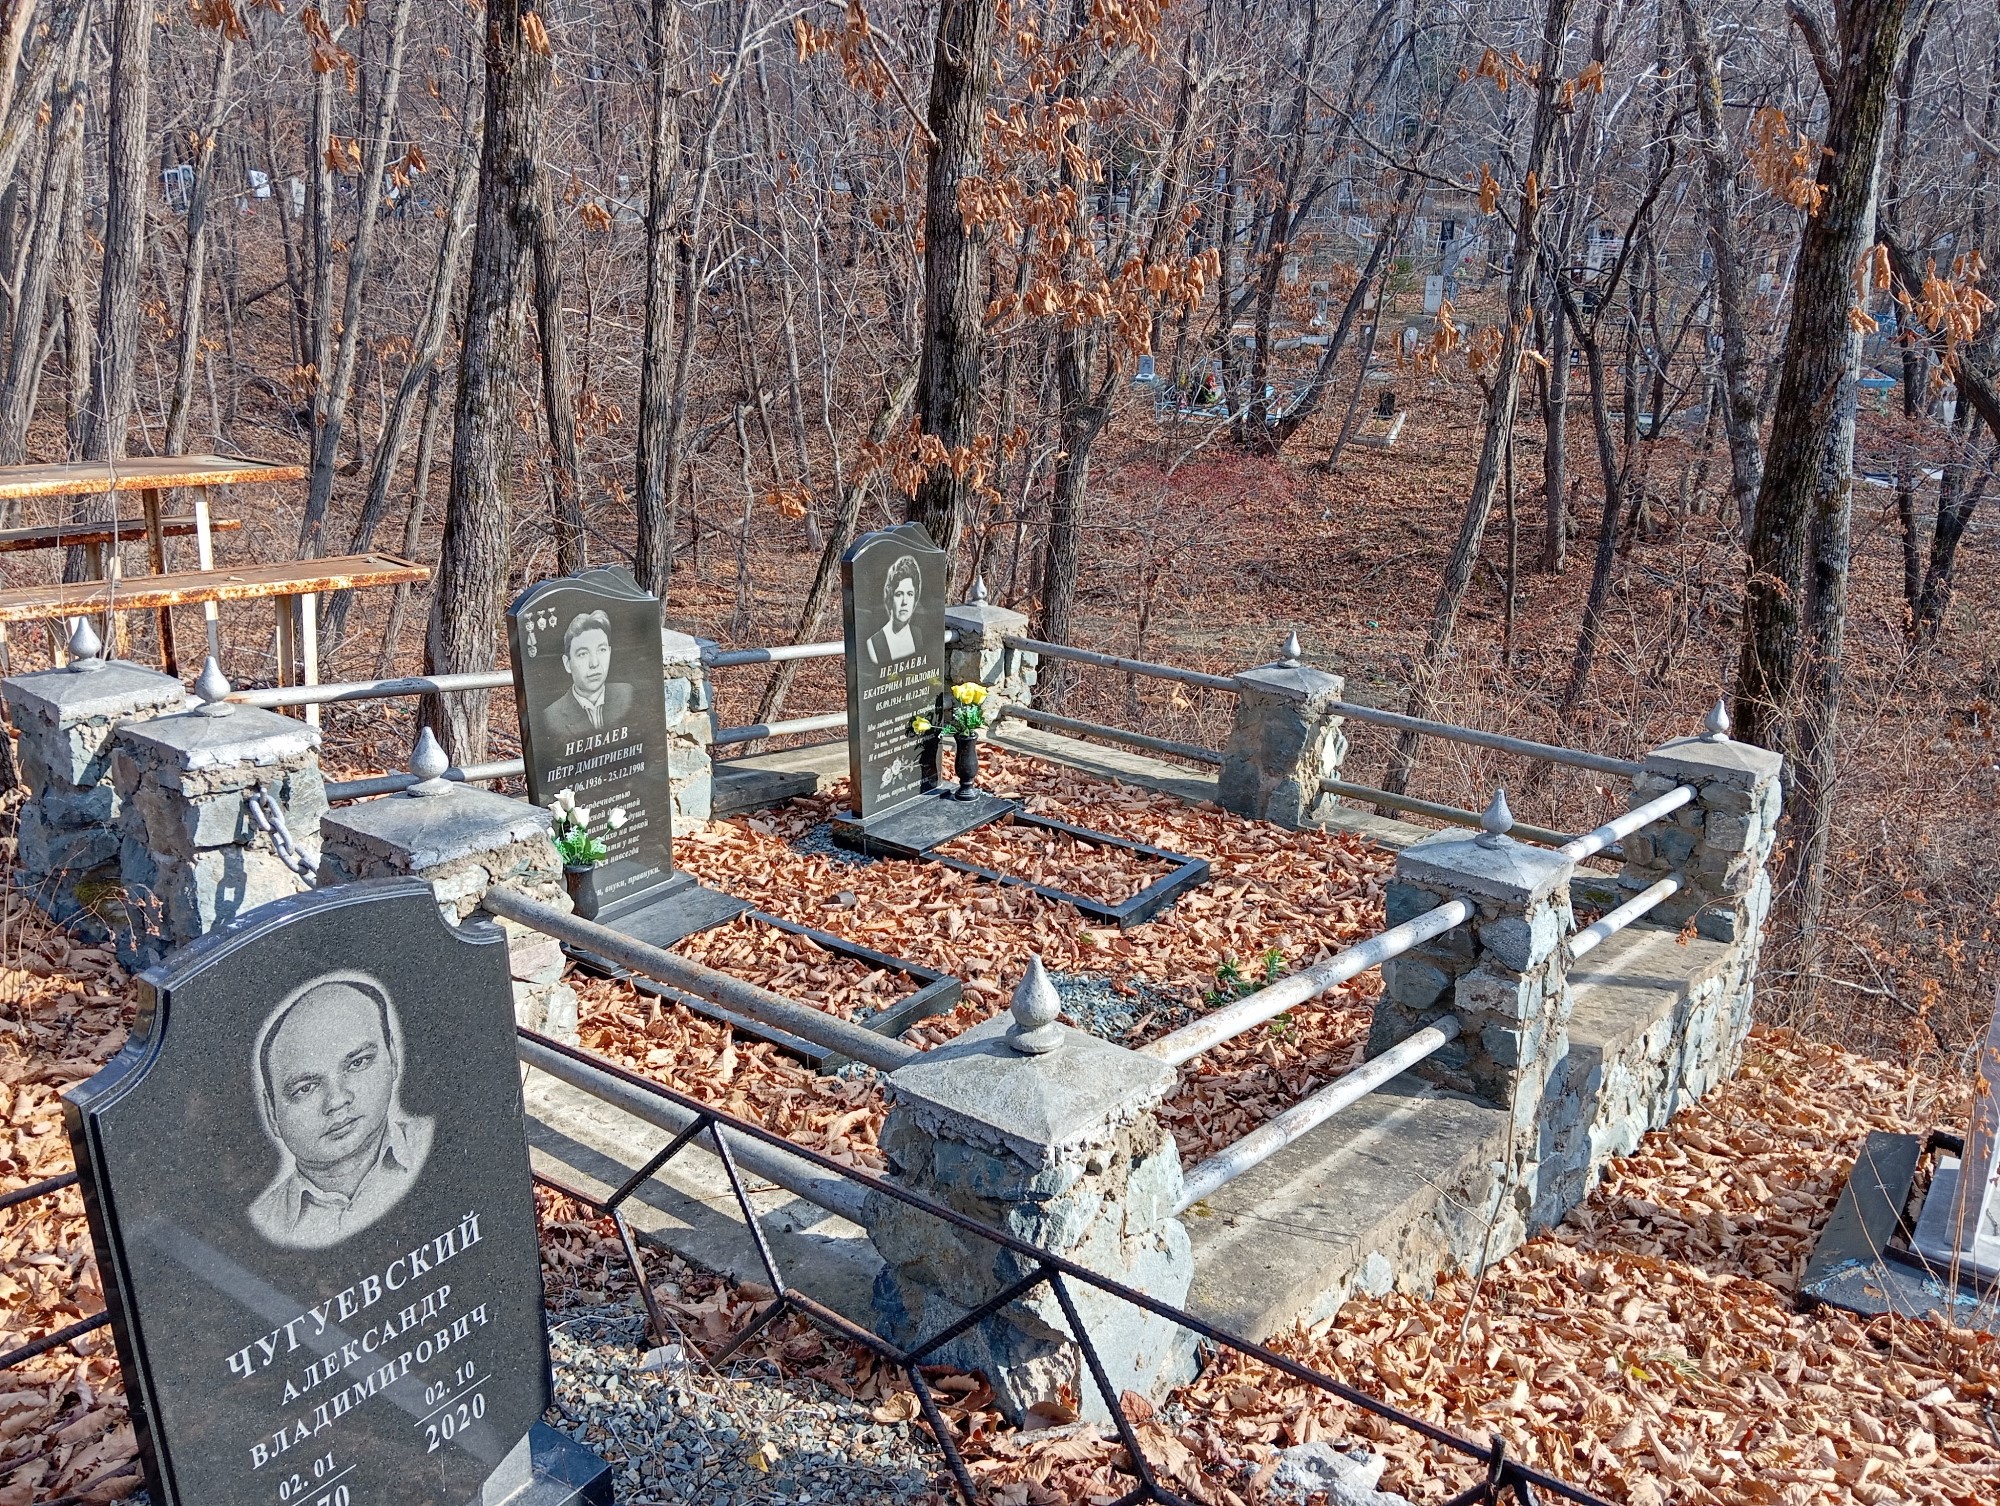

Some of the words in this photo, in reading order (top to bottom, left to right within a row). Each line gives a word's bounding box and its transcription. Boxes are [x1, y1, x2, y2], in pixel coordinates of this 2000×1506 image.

[863, 679, 903, 700] ЕКАТЕРИНА
[905, 667, 940, 687] ПАВЛОВНА
[880, 655, 927, 678] НЕДБАЕВА
[547, 764, 574, 783] ПЁТР
[574, 742, 643, 776] ДМИТРИЕВИЧ
[565, 726, 628, 757] НЕДБАЕВ
[608, 761, 645, 782] 25.12.1998
[225, 1210, 484, 1379] ЧУГУЕВСКИЙ
[282, 1284, 452, 1406] АЛЕКСАНДР
[249, 1303, 488, 1470] ВЛАДИМИРОВИЧ
[425, 1380, 451, 1405] 02.
[455, 1360, 475, 1386] 10
[425, 1393, 486, 1454] 2020
[279, 1473, 309, 1500] 02.
[314, 1451, 337, 1478] 01
